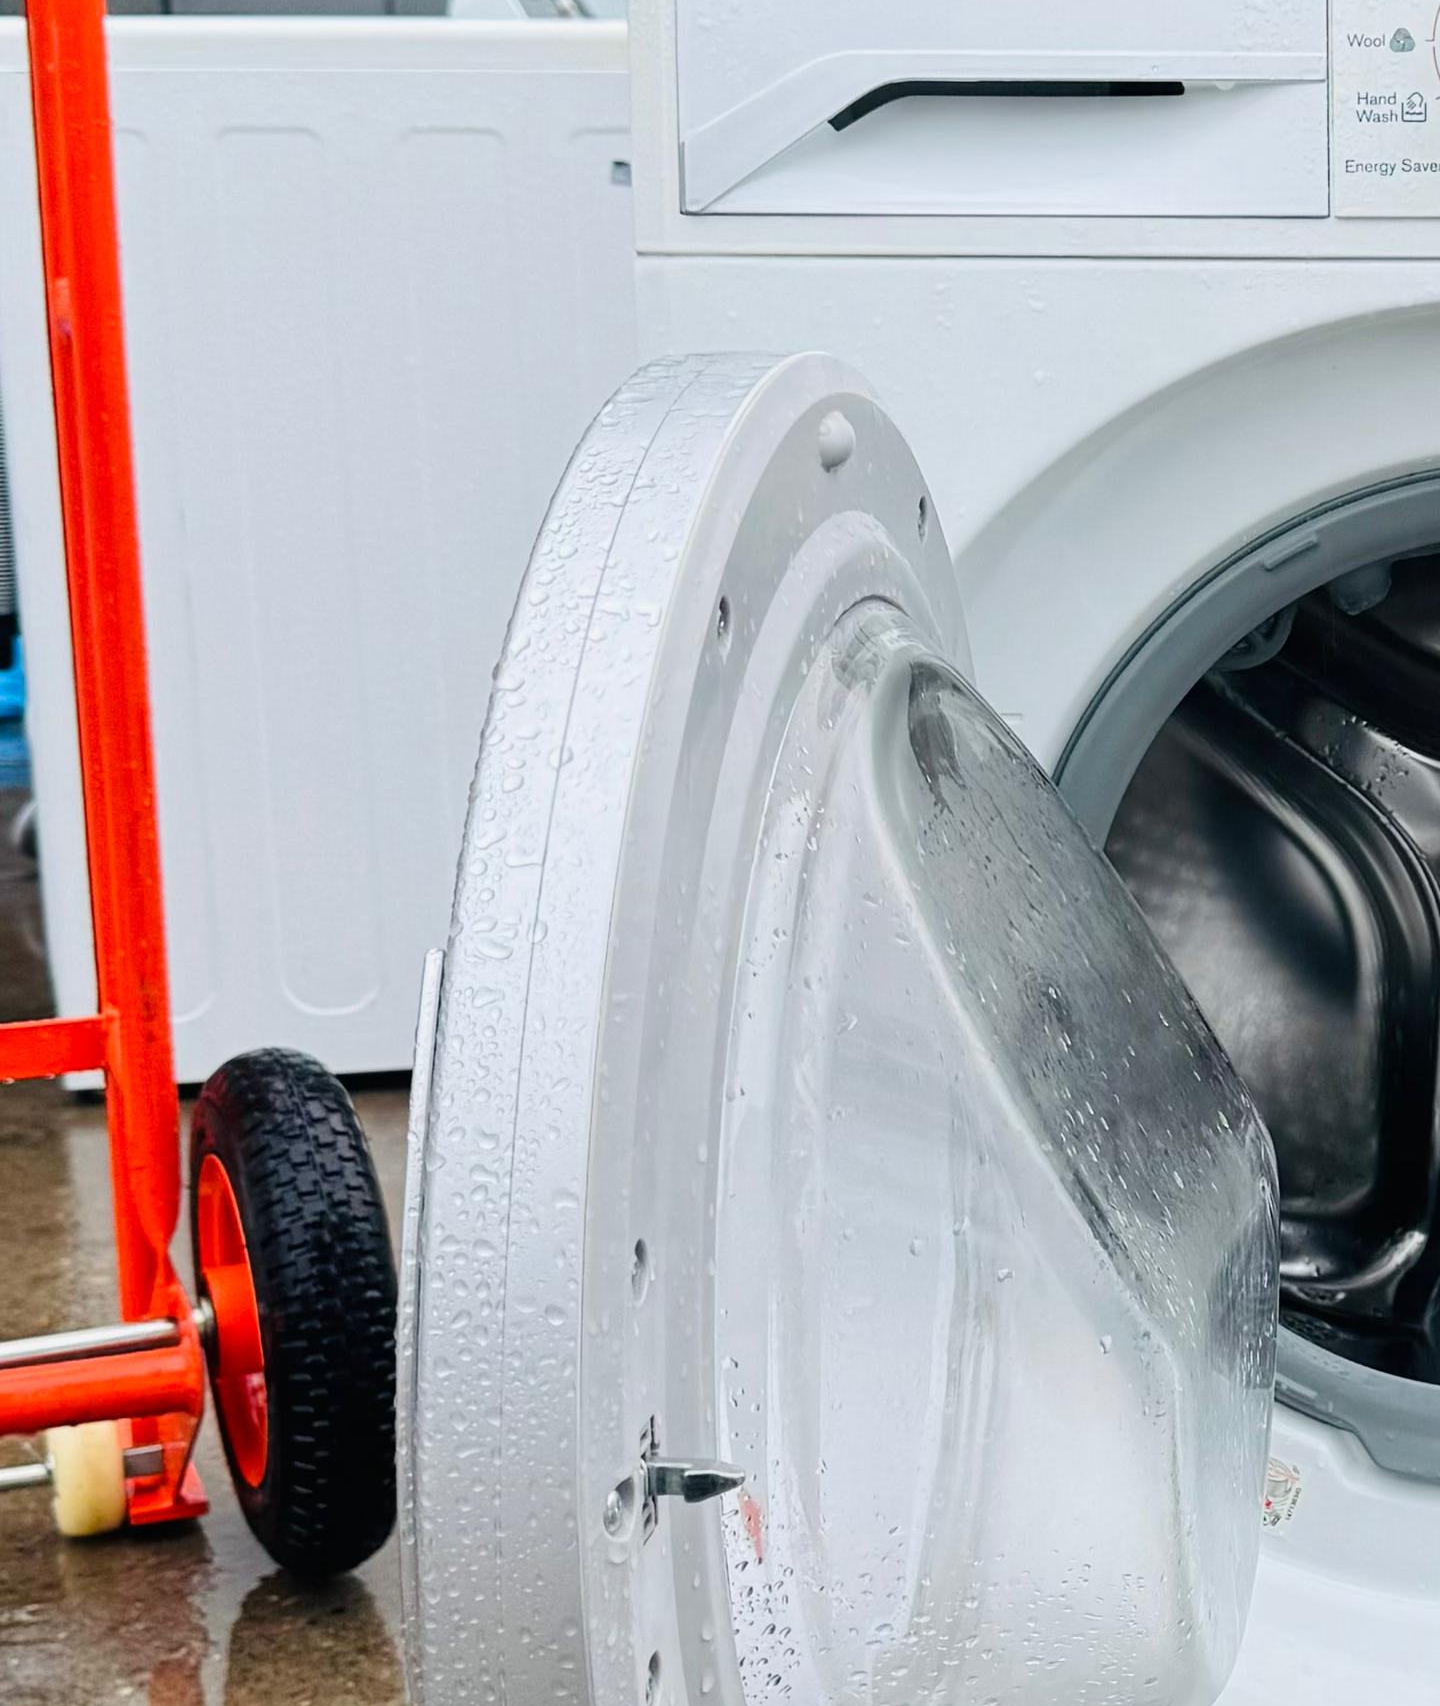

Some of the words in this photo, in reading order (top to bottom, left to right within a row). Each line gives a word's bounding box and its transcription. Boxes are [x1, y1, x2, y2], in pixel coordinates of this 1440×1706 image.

[1347, 34, 1386, 48] Wool
[1357, 92, 1397, 105] Hand
[1356, 109, 1398, 123] Wash
[1345, 159, 1397, 176] Energy
